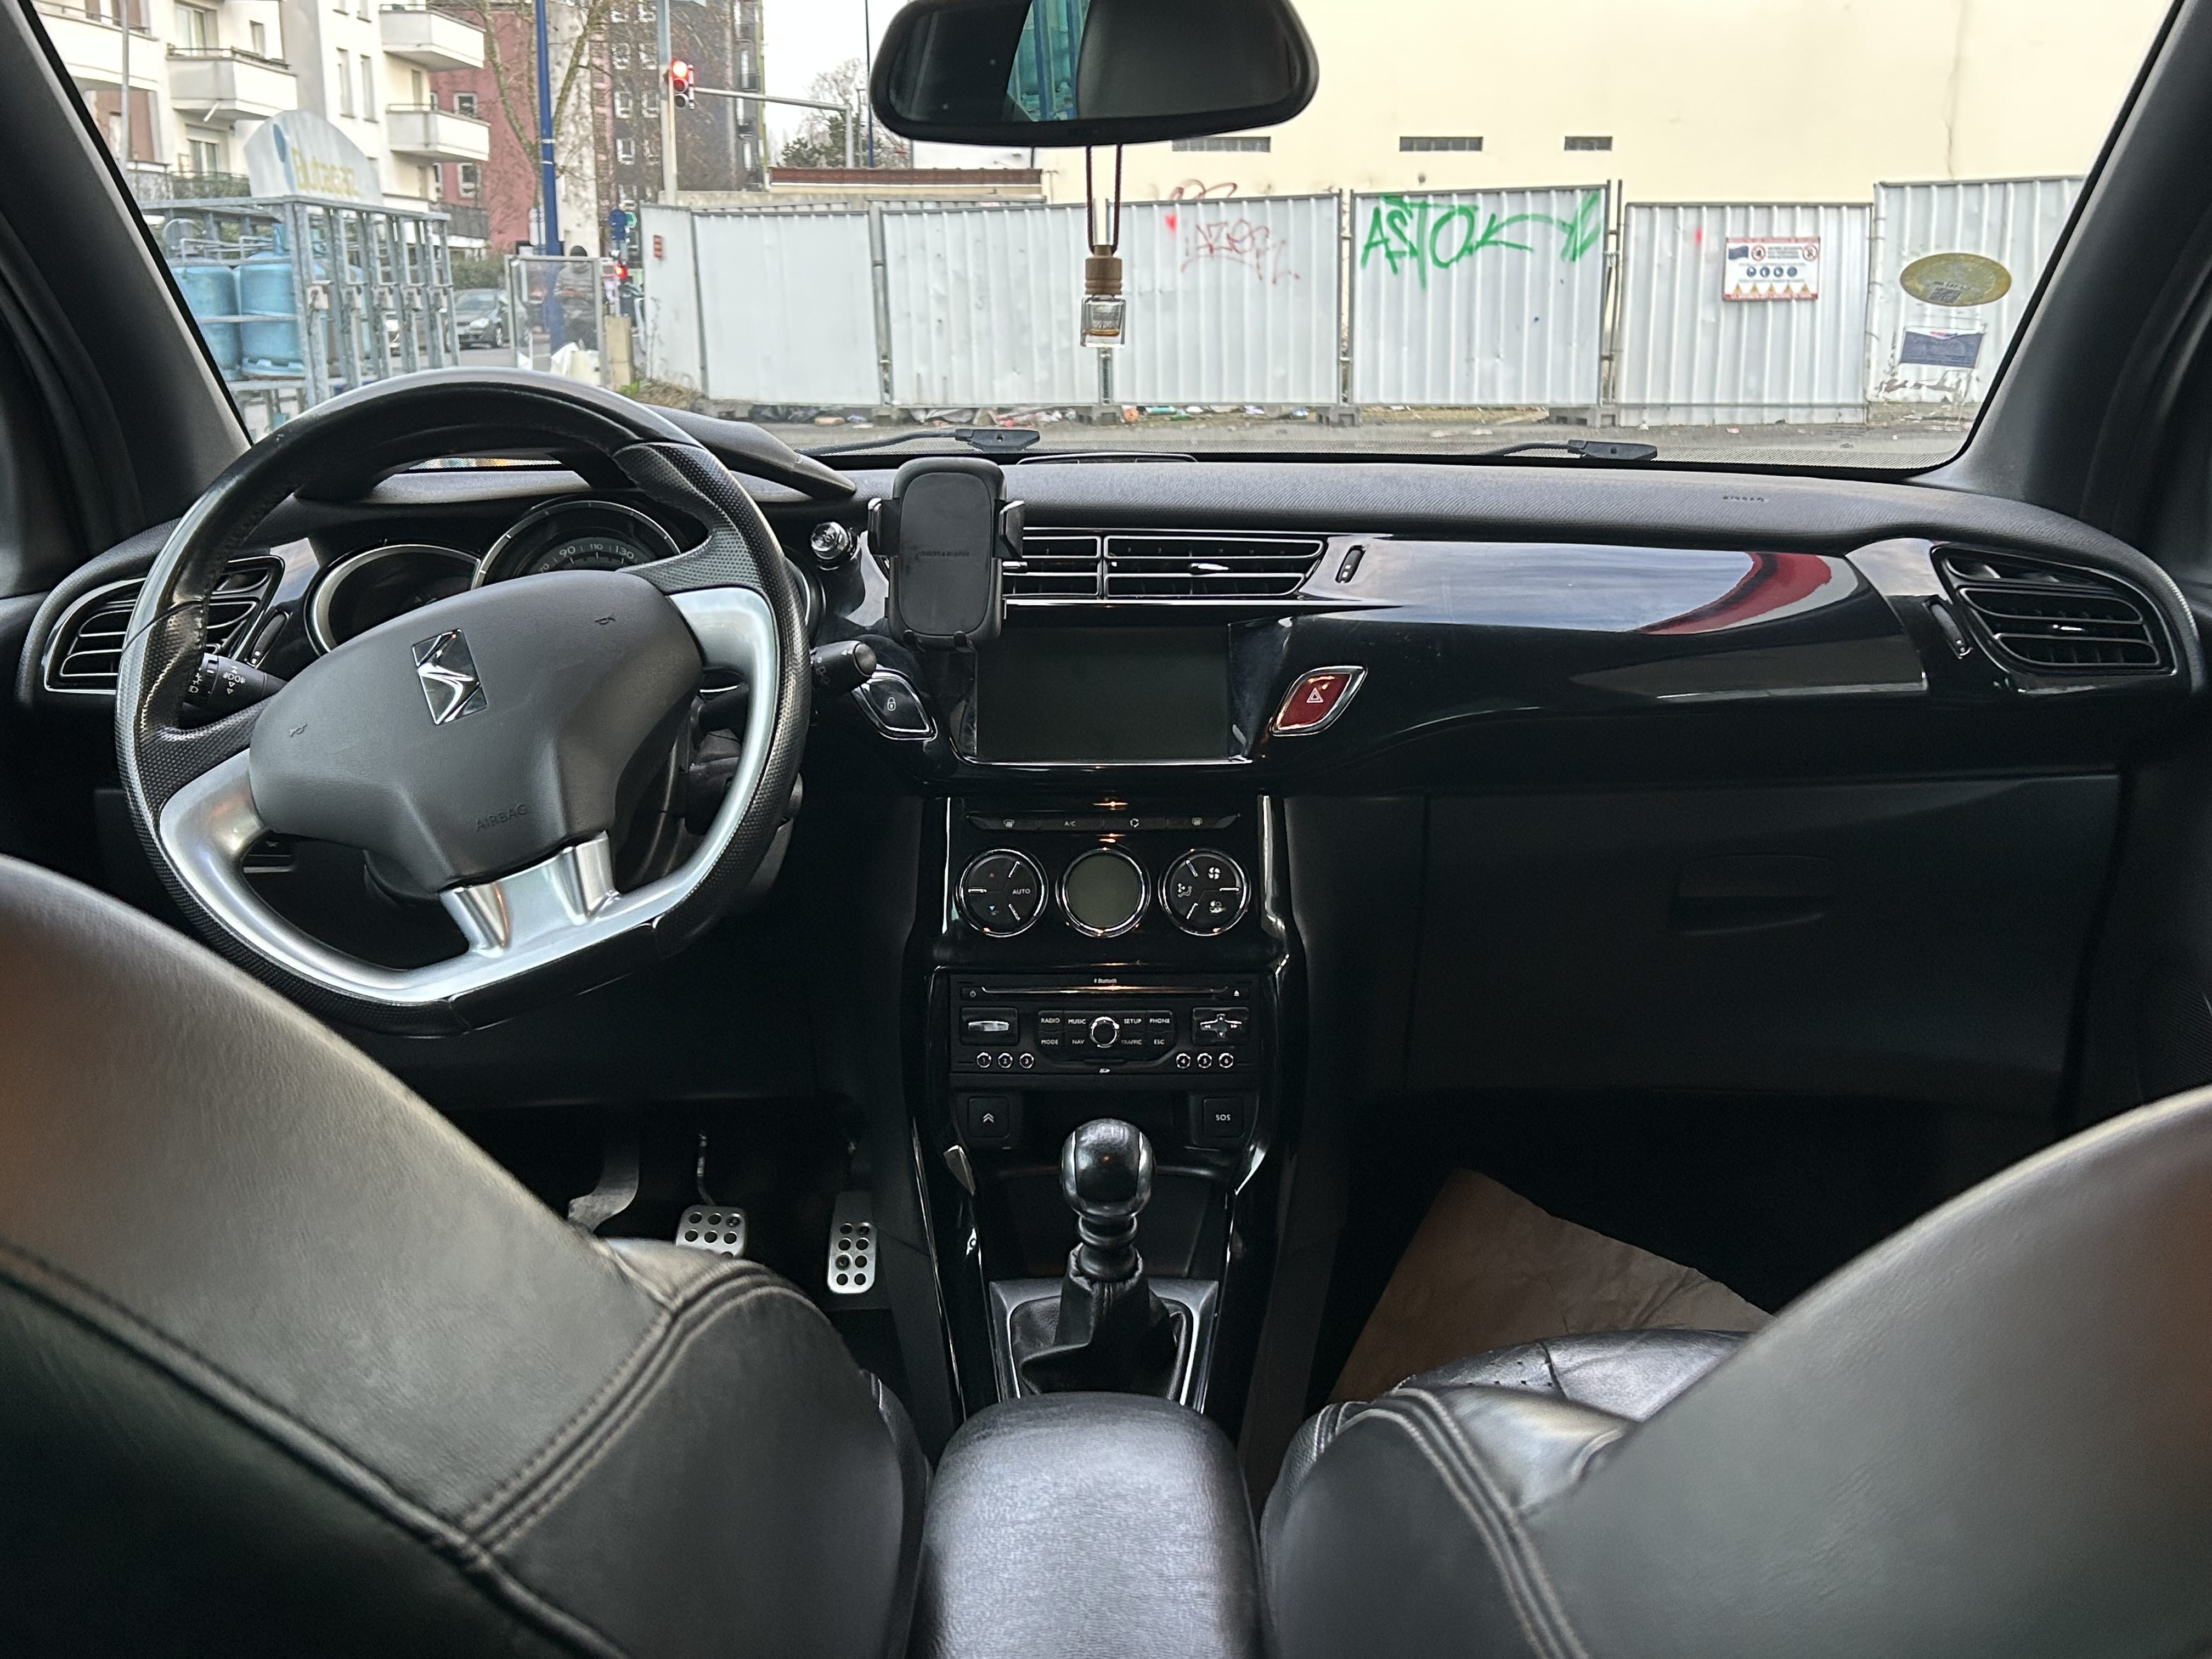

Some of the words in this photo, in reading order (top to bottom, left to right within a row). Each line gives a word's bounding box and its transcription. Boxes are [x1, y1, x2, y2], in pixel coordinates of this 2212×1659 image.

[559, 546, 575, 557] 90
[615, 545, 634, 559] 130
[476, 804, 527, 833] AIRBAG
